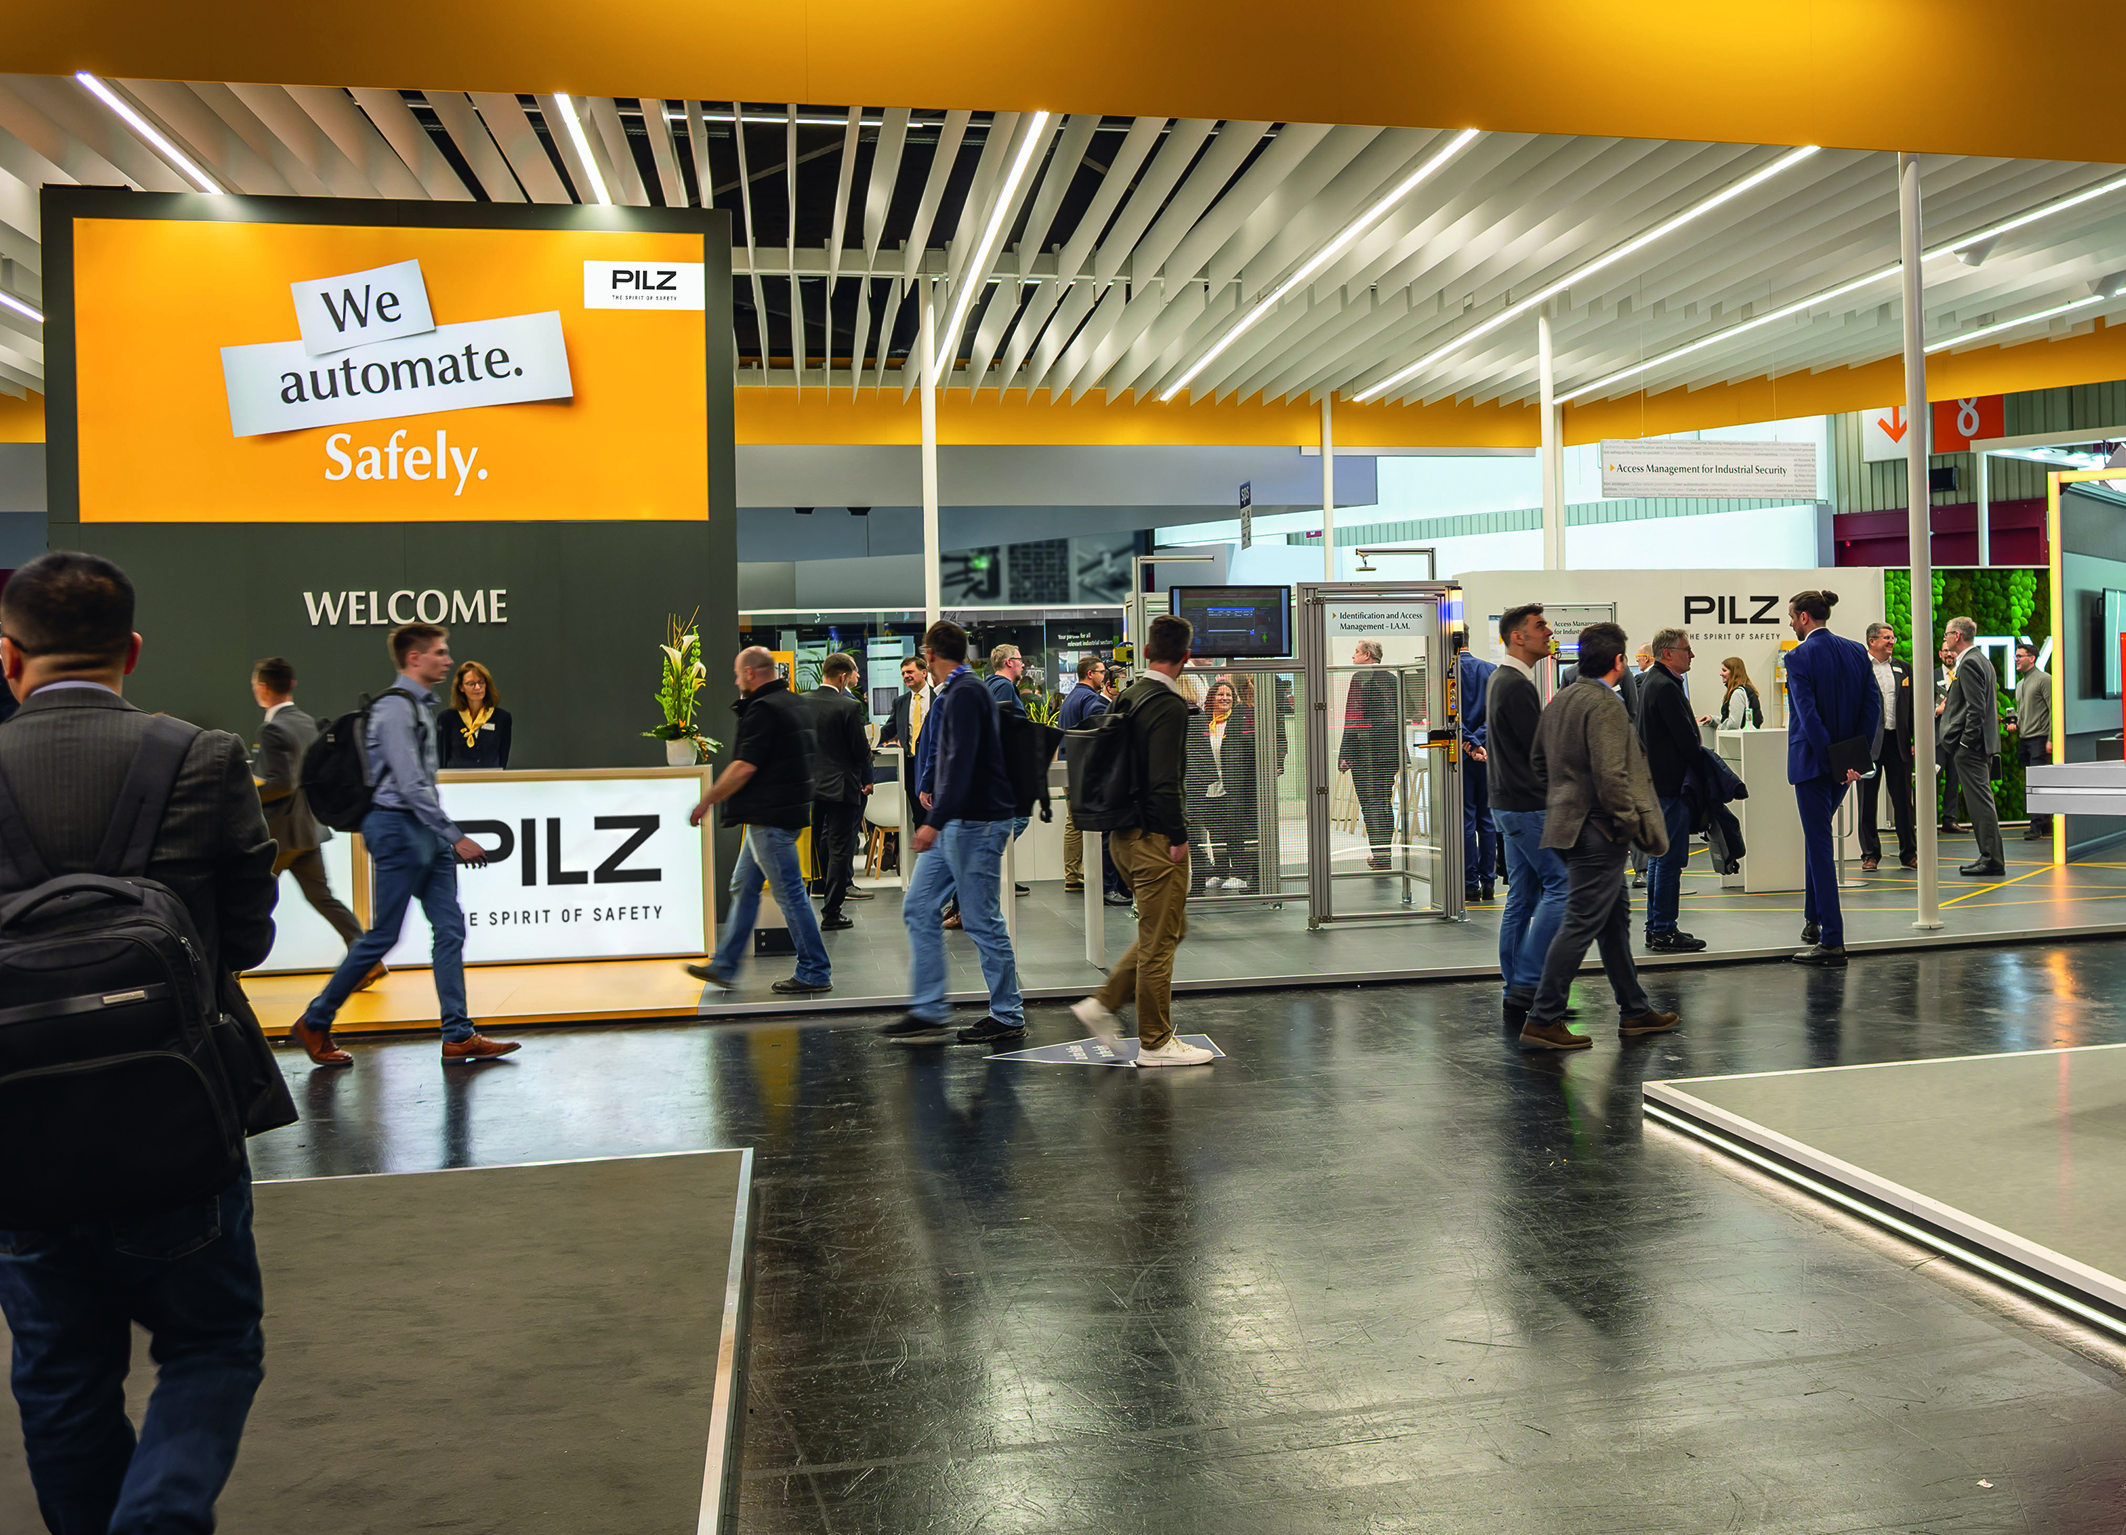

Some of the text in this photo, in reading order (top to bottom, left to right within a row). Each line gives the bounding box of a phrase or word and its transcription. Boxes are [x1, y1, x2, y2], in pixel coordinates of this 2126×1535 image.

[612, 269, 677, 291] PILZ
[321, 284, 402, 333] We
[280, 344, 523, 405] automate.
[1956, 397, 1980, 437] 8
[324, 428, 488, 496] Safely.
[1616, 464, 1644, 472] Access
[1646, 464, 1700, 476] Management
[1701, 463, 1713, 474] for
[1715, 464, 1754, 475] Industrial
[1754, 465, 1788, 477] Security
[302, 589, 508, 626] WELCOME
[1339, 611, 1423, 620] Identification and Access
[1684, 595, 1780, 625] PILZ
[1339, 622, 1385, 632] Management
[1390, 622, 1411, 631] I.A.M.
[1690, 633, 1781, 641] HE SPIRIT OF SAFETY
[455, 814, 662, 887] PILZ
[489, 907, 550, 926] SPIRIT
[561, 907, 582, 923] OF
[593, 905, 662, 922] SAFETY
